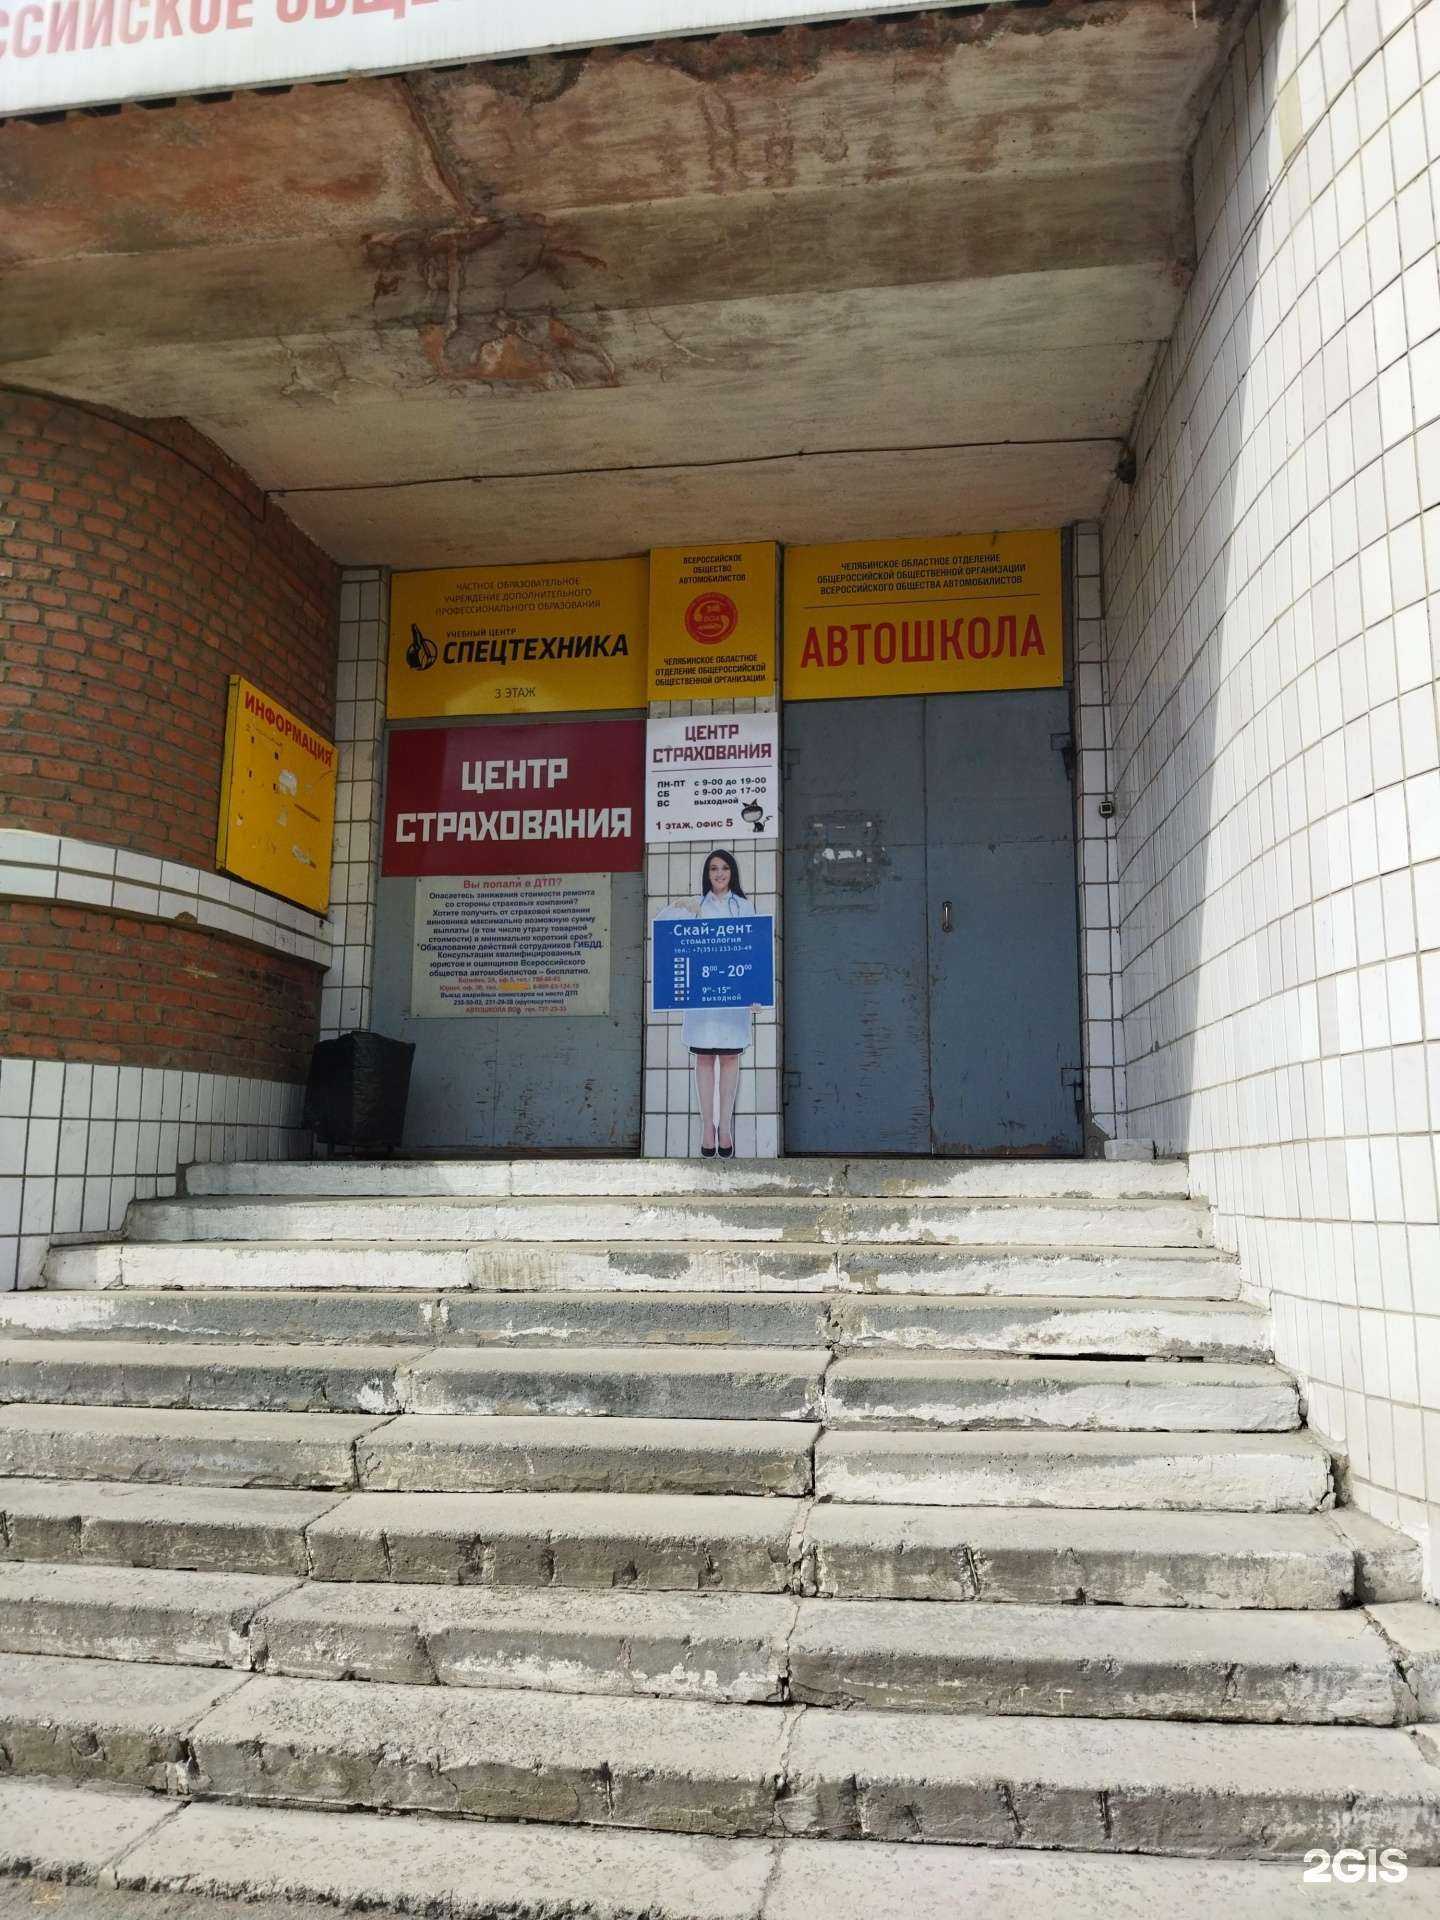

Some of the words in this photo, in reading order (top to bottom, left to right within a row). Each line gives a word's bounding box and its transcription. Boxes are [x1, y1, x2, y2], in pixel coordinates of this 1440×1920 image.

[683, 554, 742, 564] ВСЕРОССИЙСКОЕ
[841, 560, 898, 570] ЧЕЛЯБИНСКОЕ
[901, 557, 950, 567] ОБЛАСТНОЕ
[952, 554, 1000, 565] ОТДЕЛЕНИЕ
[693, 565, 732, 574] ОБЩЕСТВО
[817, 571, 894, 584] ОБЩЕРОССИЙСКОЙ
[897, 568, 962, 579] ОБЩЕСТВЕННОЙ
[965, 564, 1026, 575] ОРГАНИЗАЦИИ
[678, 574, 746, 584] АВТОМОБИЛИСТОВ
[820, 583, 893, 595] ВСЕРОССИЙСКОГО
[896, 580, 941, 591] ОБЩЕСТВА
[943, 576, 1022, 588] АВТОМОБИЛИСТОВ
[446, 629, 486, 638] УЧЕБНЫЙ
[489, 628, 517, 638] ЦЕНТР
[800, 614, 1047, 669] АВТОШКОЛА
[442, 634, 629, 666] СПЕЦТЕХНИКА
[664, 656, 713, 665] ЧЕЛЯБИНСКОЕ
[716, 654, 757, 664] ОБЛАСТНОЕ
[656, 667, 696, 676] ОТДЕЛЕНИЕ
[698, 663, 766, 674] ОБЩЕРОССИЙСКОЙ
[656, 677, 712, 686] ОБЩЕСТВЕННОЙ
[714, 674, 766, 684] ОРГАНИЗАЦИИ
[495, 688, 501, 699] 3
[505, 687, 536, 698] ЭТАЖ
[244, 691, 334, 768] ИНФОРМАЦИЯ
[685, 724, 739, 742] ЦЕНТР
[653, 743, 772, 763] СТРАХОВАНИЯ
[461, 758, 568, 795] ЦЕНТР
[657, 780, 686, 788] ПН-ПТ
[702, 779, 723, 787] 9-00
[725, 779, 737, 788] до
[741, 777, 767, 786] 19-00
[702, 788, 723, 796] 9-00
[725, 788, 737, 797] до
[741, 786, 767, 795] 17-00
[657, 800, 670, 808] ВС
[694, 797, 739, 806] выходной
[396, 807, 632, 843] СТРАХОВАНИЯ
[656, 821, 661, 830] 1
[696, 819, 723, 828] ОФИС
[725, 818, 734, 827] 5
[464, 880, 480, 889] Вы
[483, 880, 521, 888] попали
[563, 889, 595, 898] ремонта
[457, 901, 490, 909] стороны
[461, 910, 498, 919] получить
[673, 922, 753, 937] Скай-дент
[680, 937, 742, 945] стоматология
[520, 942, 570, 952] сотрудников
[520, 959, 585, 968] Всероссийского
[702, 994, 742, 1003] выходной
